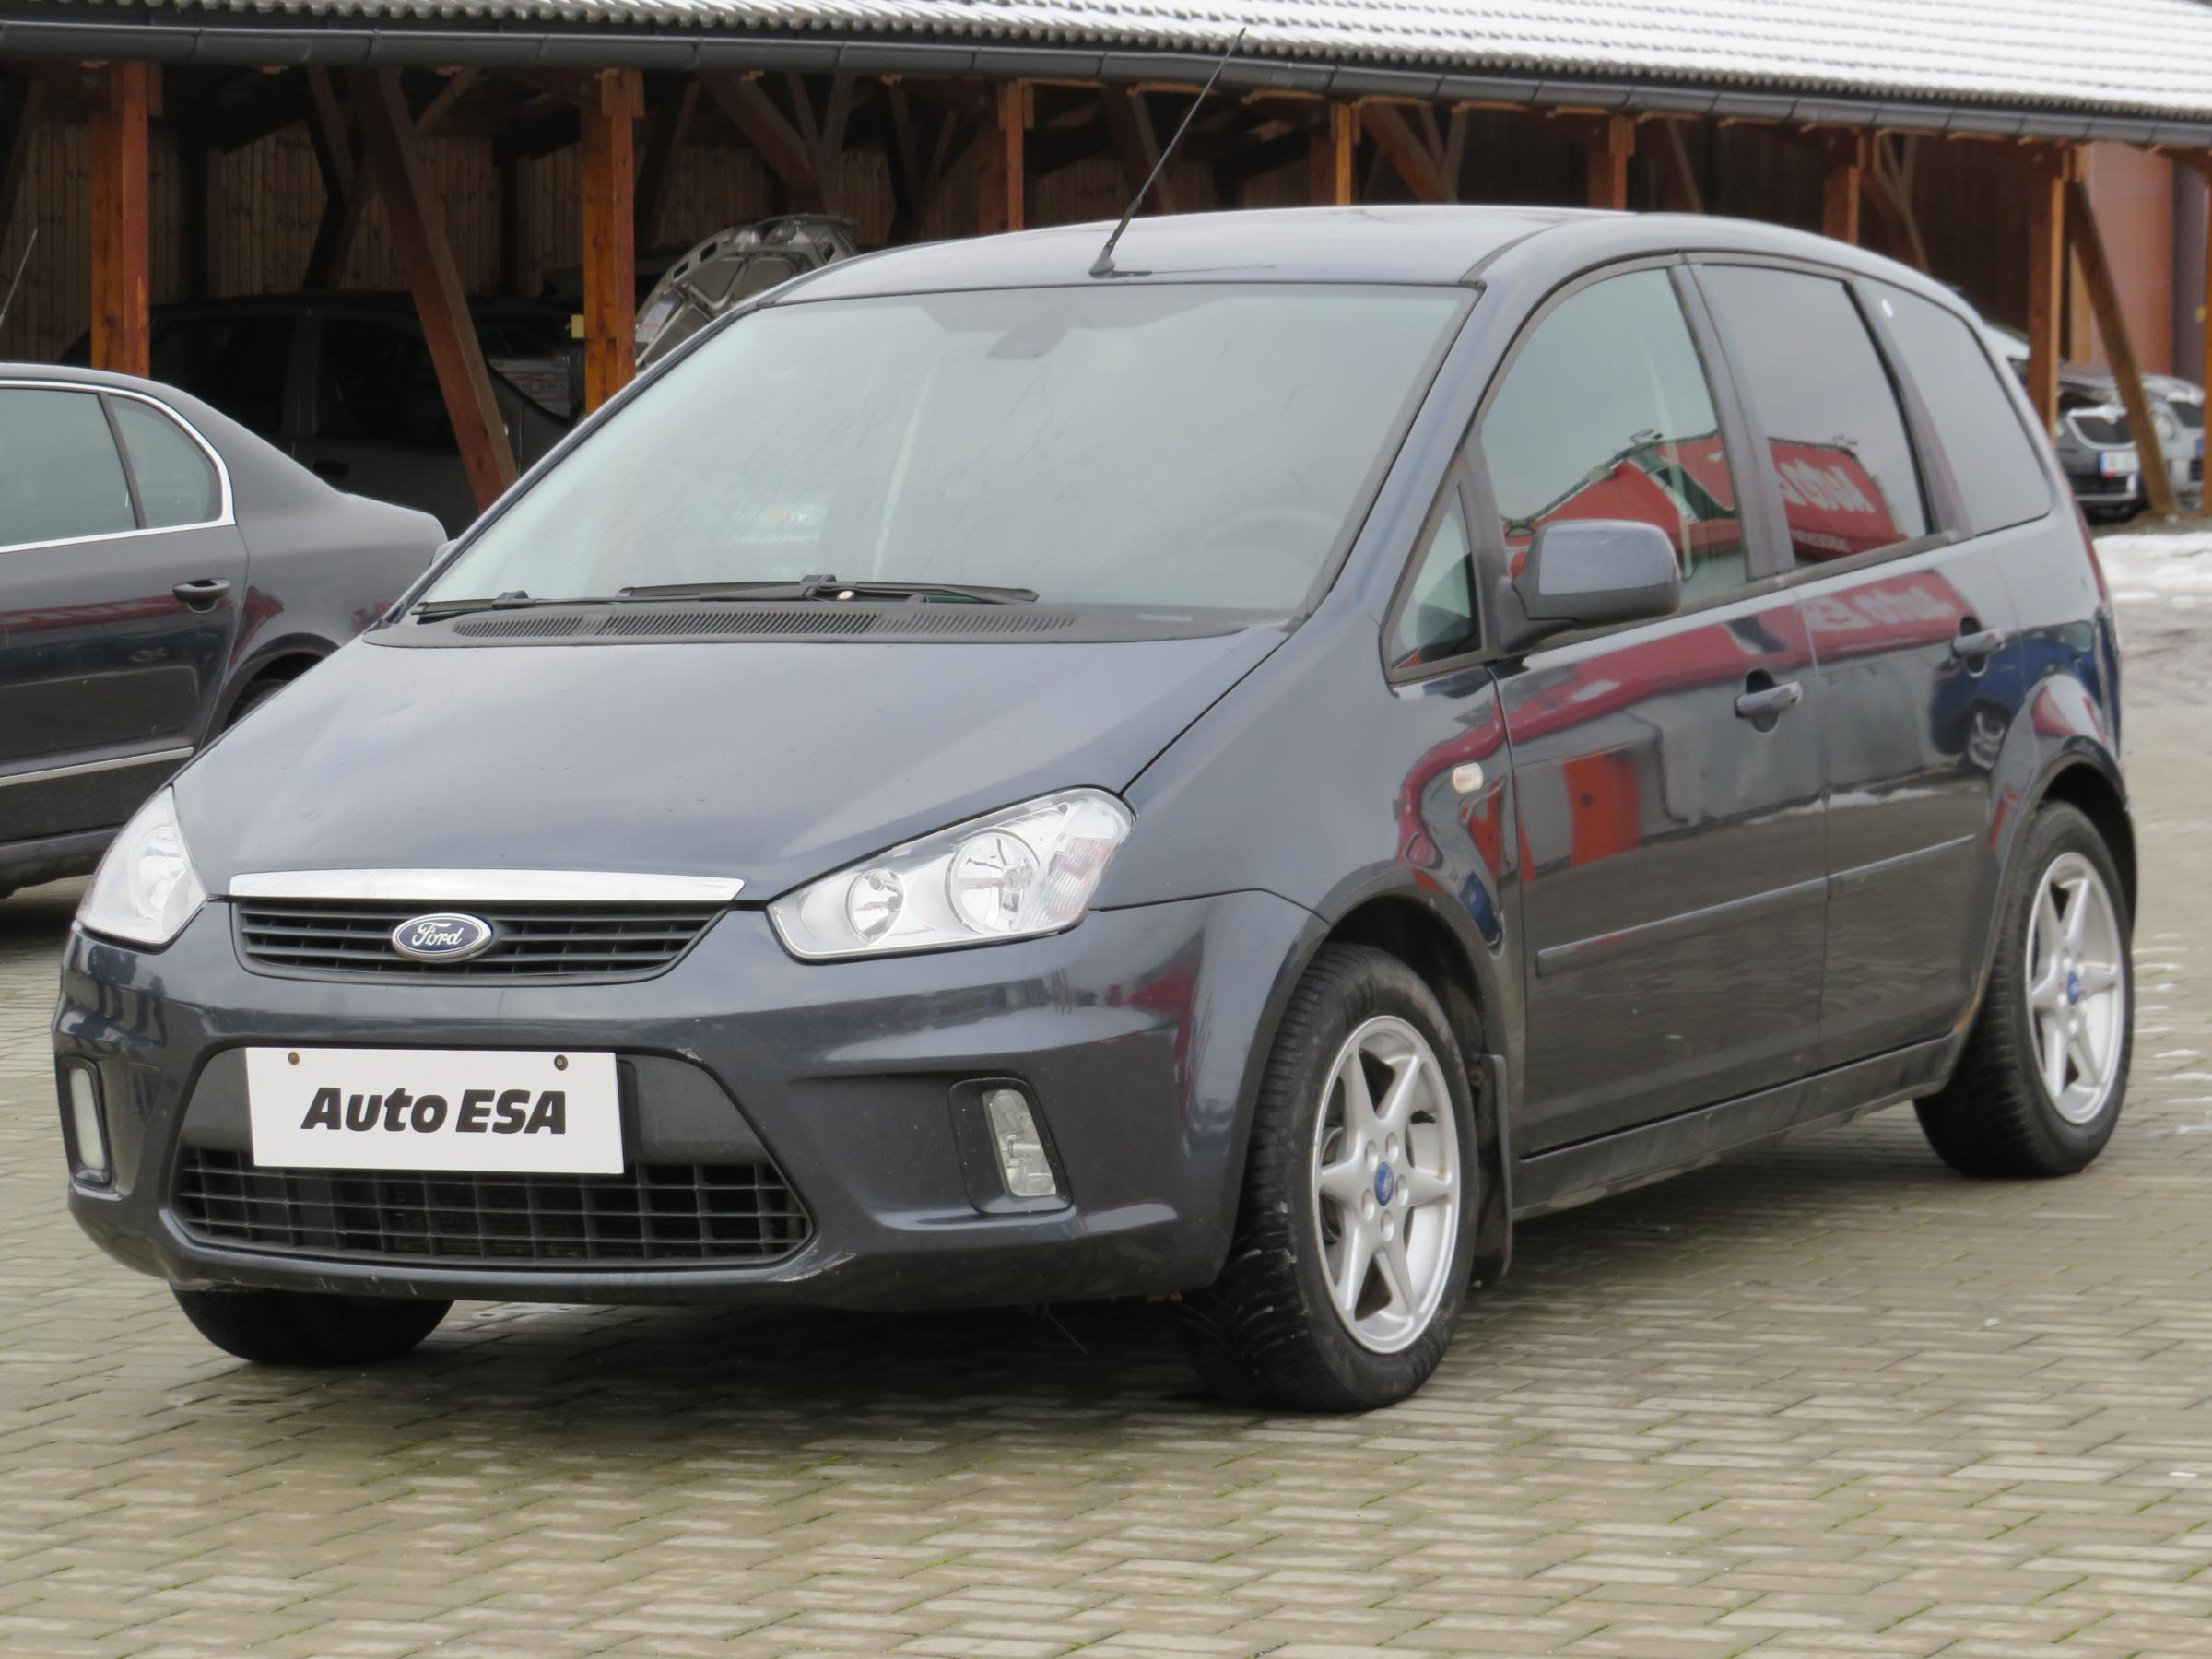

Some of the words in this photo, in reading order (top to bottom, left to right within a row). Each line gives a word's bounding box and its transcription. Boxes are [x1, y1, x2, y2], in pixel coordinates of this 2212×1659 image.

[411, 922, 464, 946] Ford
[300, 1087, 448, 1133] Auto
[455, 1088, 566, 1135] ESA
